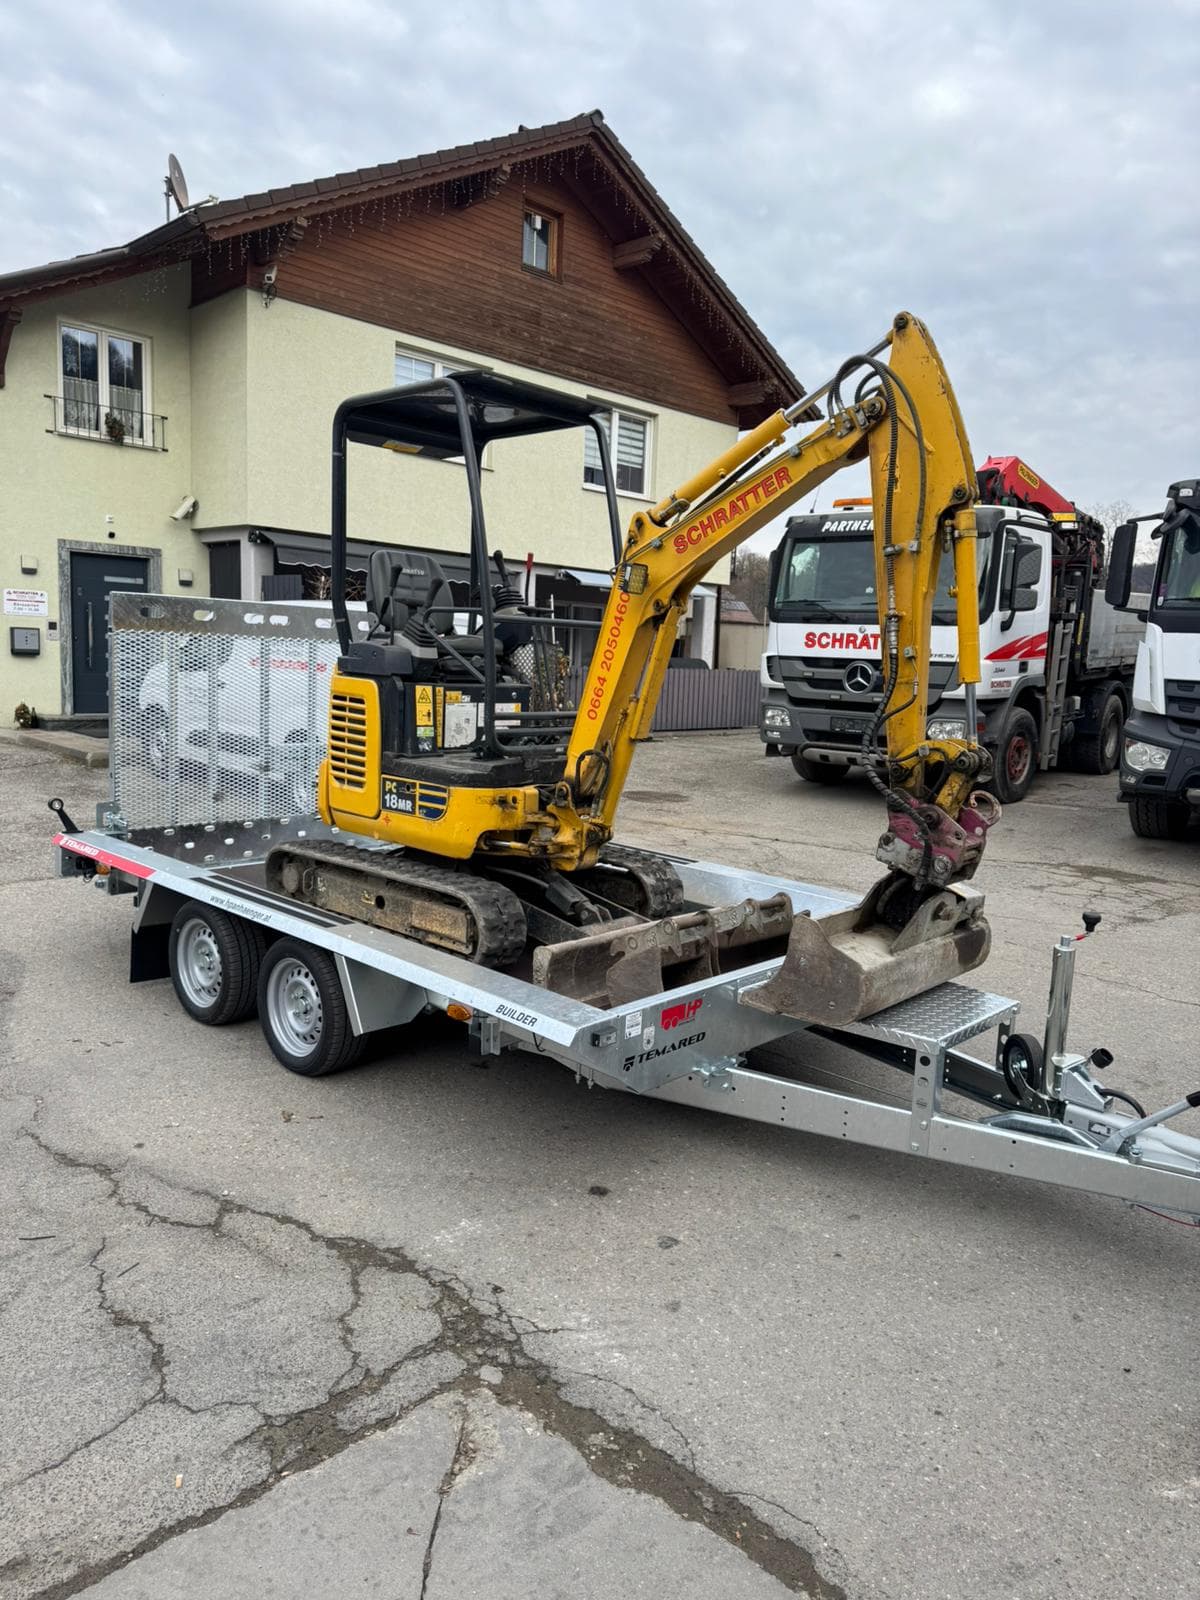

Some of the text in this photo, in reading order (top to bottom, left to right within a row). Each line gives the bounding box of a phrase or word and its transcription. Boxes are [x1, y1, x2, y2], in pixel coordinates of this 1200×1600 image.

[673, 466, 792, 554] SCHRATTER
[587, 591, 631, 721] 0664 2050460
[385, 780, 397, 793] PC
[384, 793, 413, 812] 18MR
[495, 1004, 538, 1027] BUILDER
[637, 1031, 706, 1064] TEMARED
